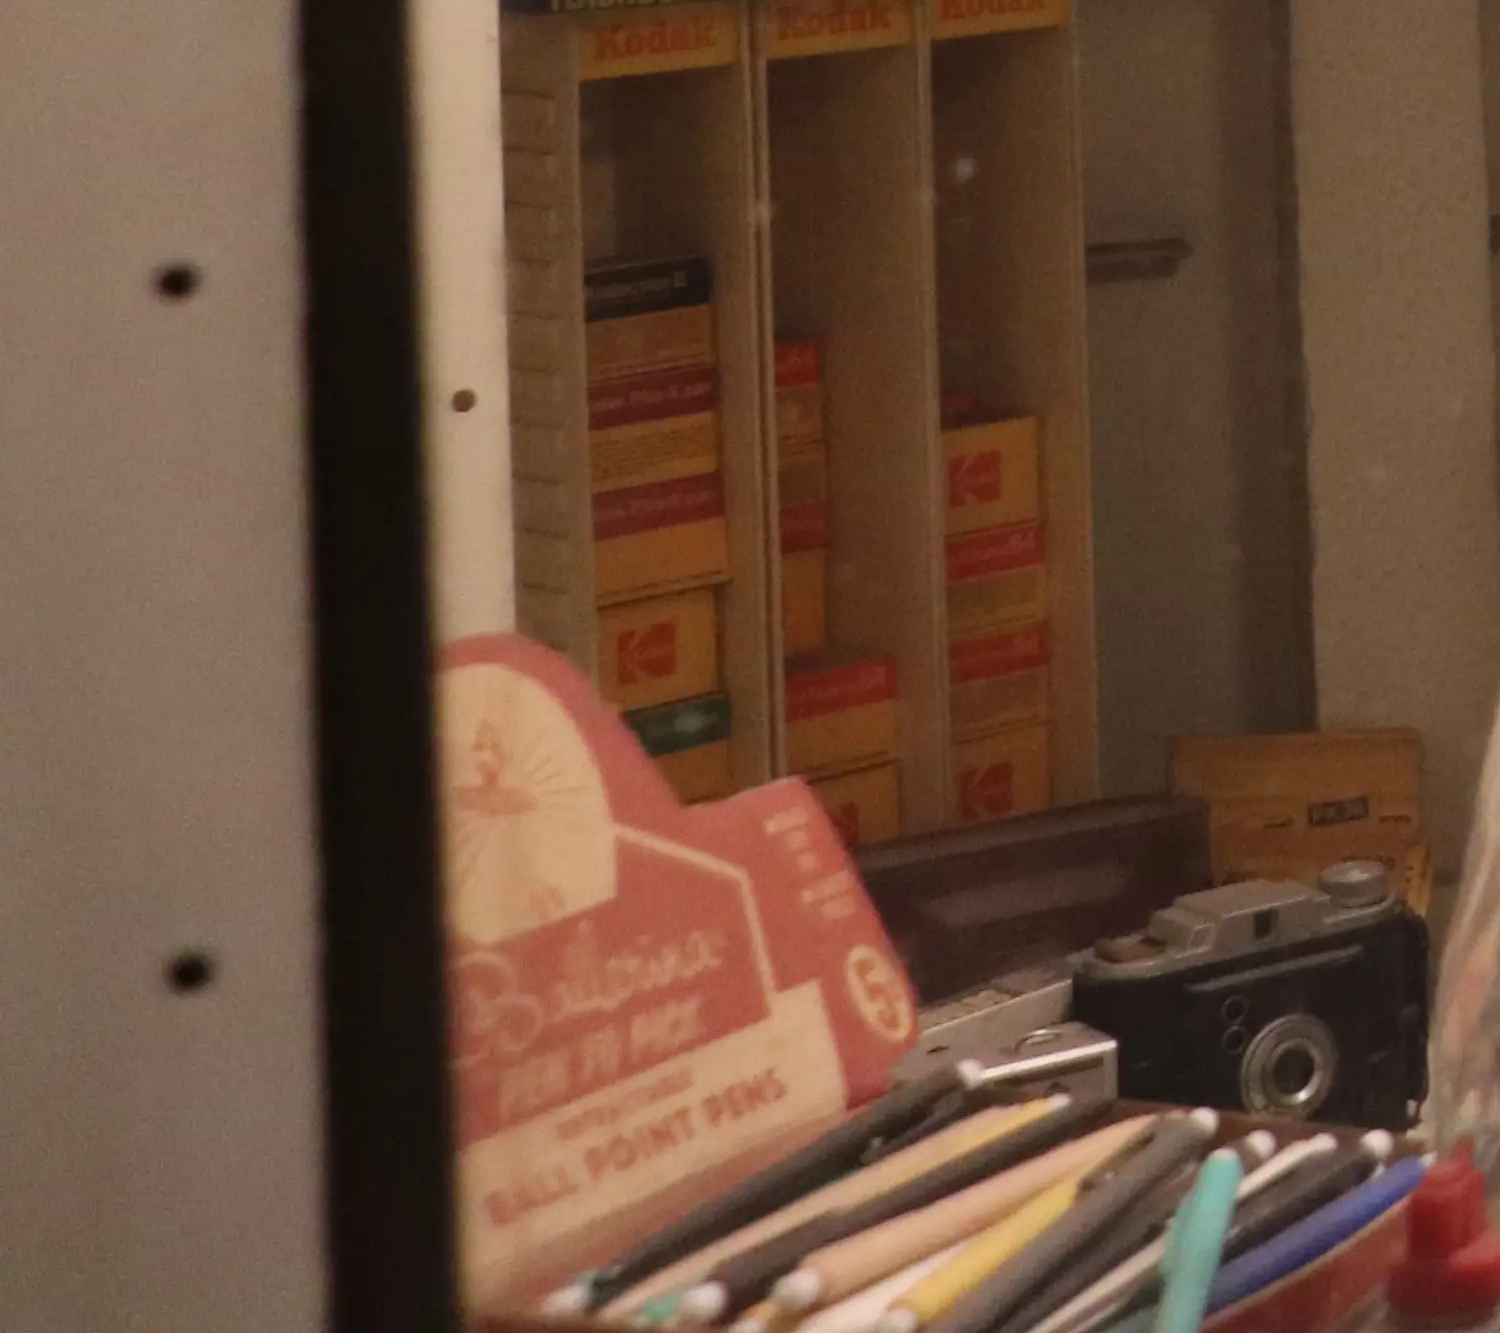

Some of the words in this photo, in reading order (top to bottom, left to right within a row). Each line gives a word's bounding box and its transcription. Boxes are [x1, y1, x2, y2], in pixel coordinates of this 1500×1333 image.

[774, 0, 891, 39] Kodak
[482, 1173, 581, 1225] BALL
[582, 1109, 697, 1179] POINT
[700, 1066, 790, 1129] PENS
